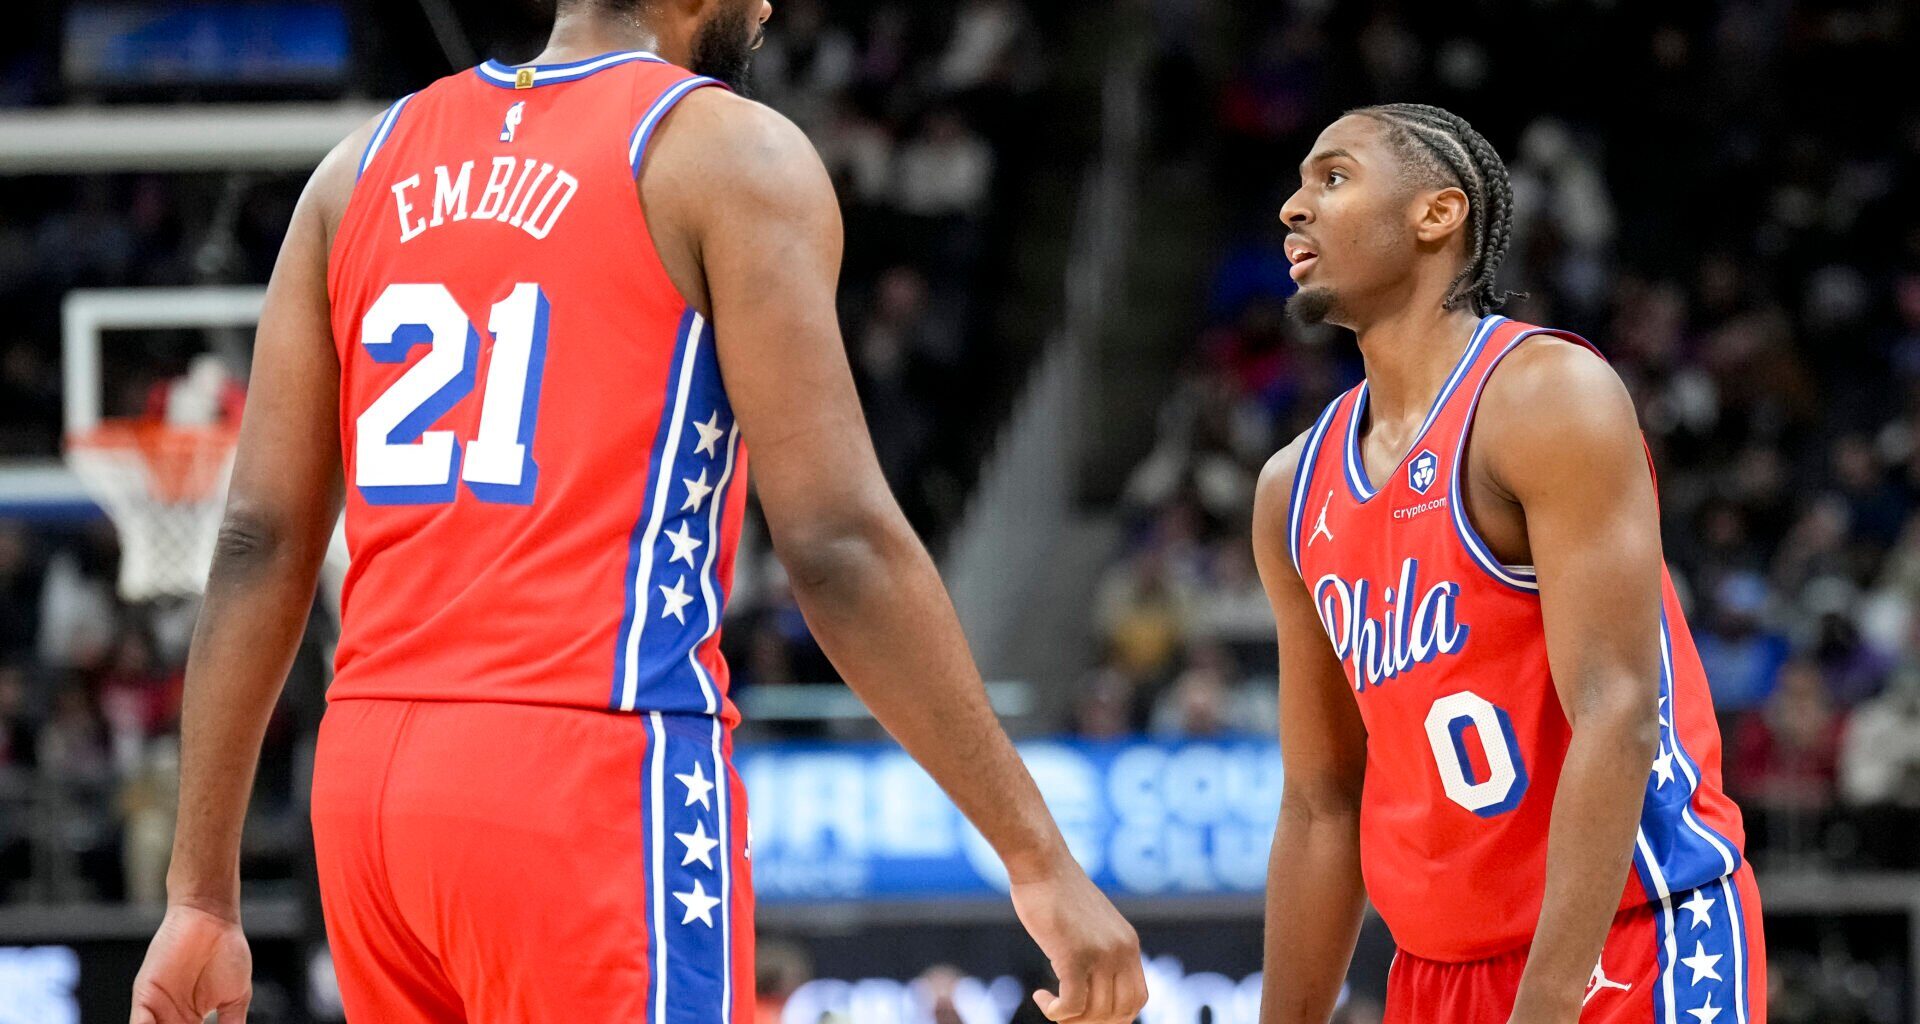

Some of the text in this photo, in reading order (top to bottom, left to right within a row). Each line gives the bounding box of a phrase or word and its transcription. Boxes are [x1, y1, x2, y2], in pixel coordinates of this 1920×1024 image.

[391, 156, 579, 243] EMBIID
[357, 282, 549, 505] 21
[1393, 497, 1447, 519] crypto.com
[1313, 557, 1470, 693] Phila
[1423, 690, 1529, 818] 0
